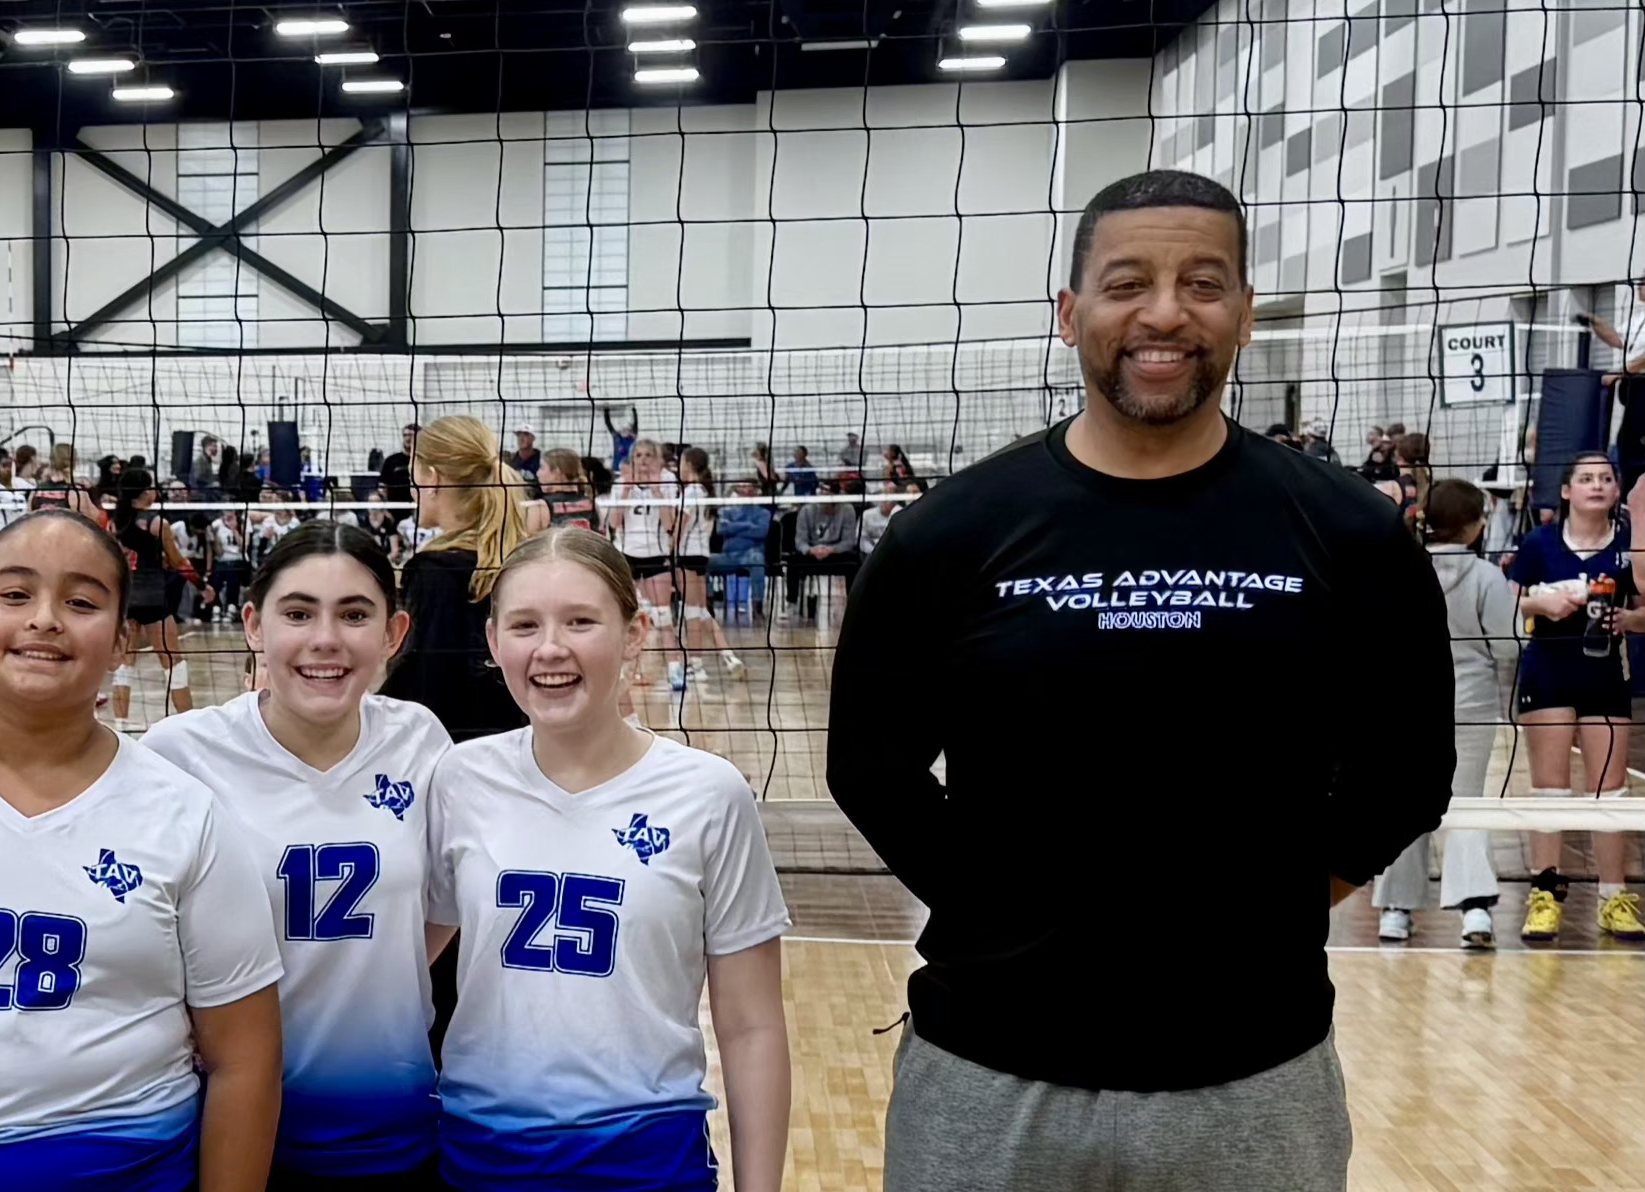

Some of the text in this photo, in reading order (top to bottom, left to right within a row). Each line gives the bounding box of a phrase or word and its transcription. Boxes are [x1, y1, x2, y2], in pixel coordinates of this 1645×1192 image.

[1447, 334, 1506, 351] COURT
[1470, 353, 1485, 392] 3
[995, 569, 1304, 598] TEXAS ADVANTAGE
[1045, 590, 1255, 612] VOLLEYBALL
[1098, 611, 1202, 630] HOUSTON
[369, 784, 408, 803] TAV
[619, 827, 665, 847] TAV
[86, 864, 135, 885] TAV
[276, 840, 381, 942] 12
[494, 870, 627, 978] 25
